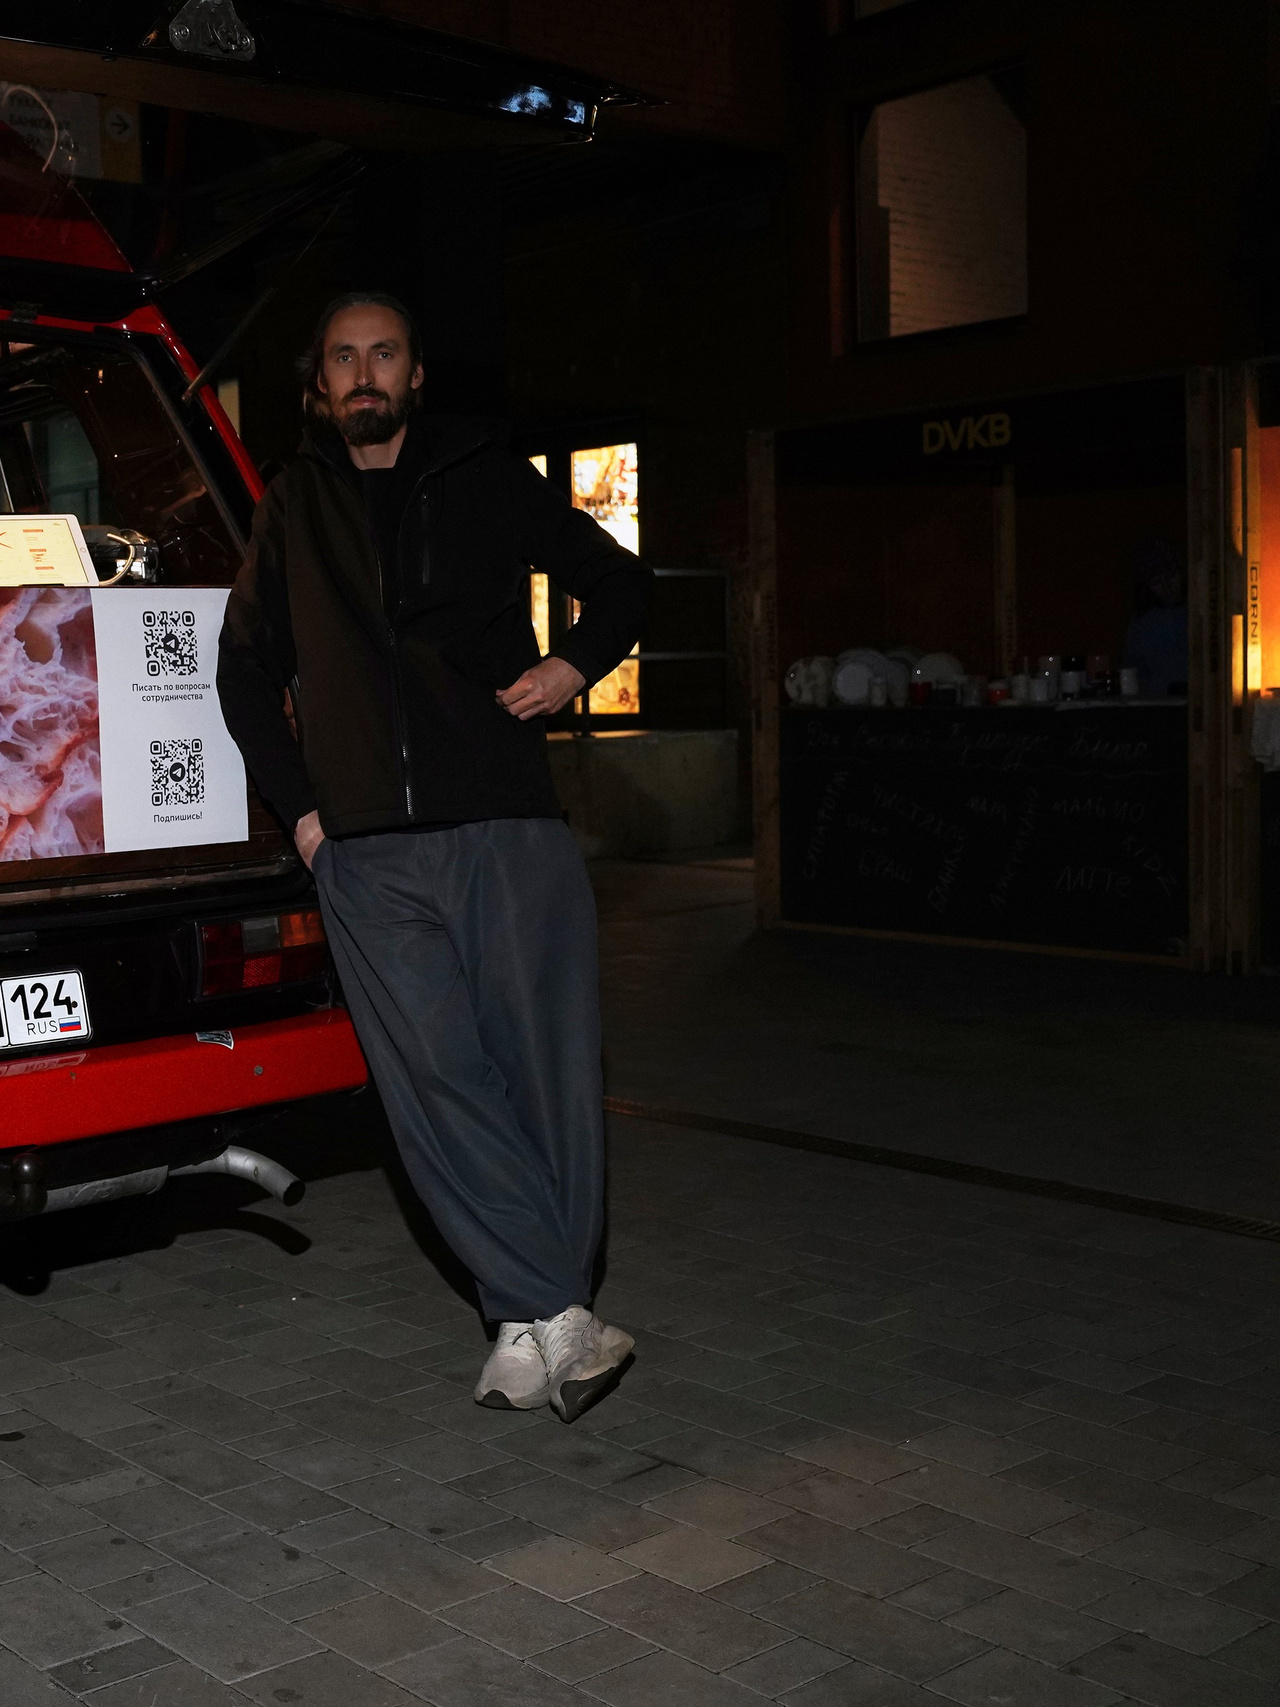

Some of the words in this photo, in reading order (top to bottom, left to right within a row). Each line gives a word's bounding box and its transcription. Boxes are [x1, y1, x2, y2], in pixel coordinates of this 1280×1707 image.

[922, 412, 1012, 456] DVKB
[132, 683, 162, 693] Писать
[175, 683, 211, 692] вопросам
[142, 692, 203, 703] сотрудничества
[154, 811, 203, 823] Подпишись!
[10, 980, 74, 1021] 124
[27, 1020, 58, 1036] RUS
